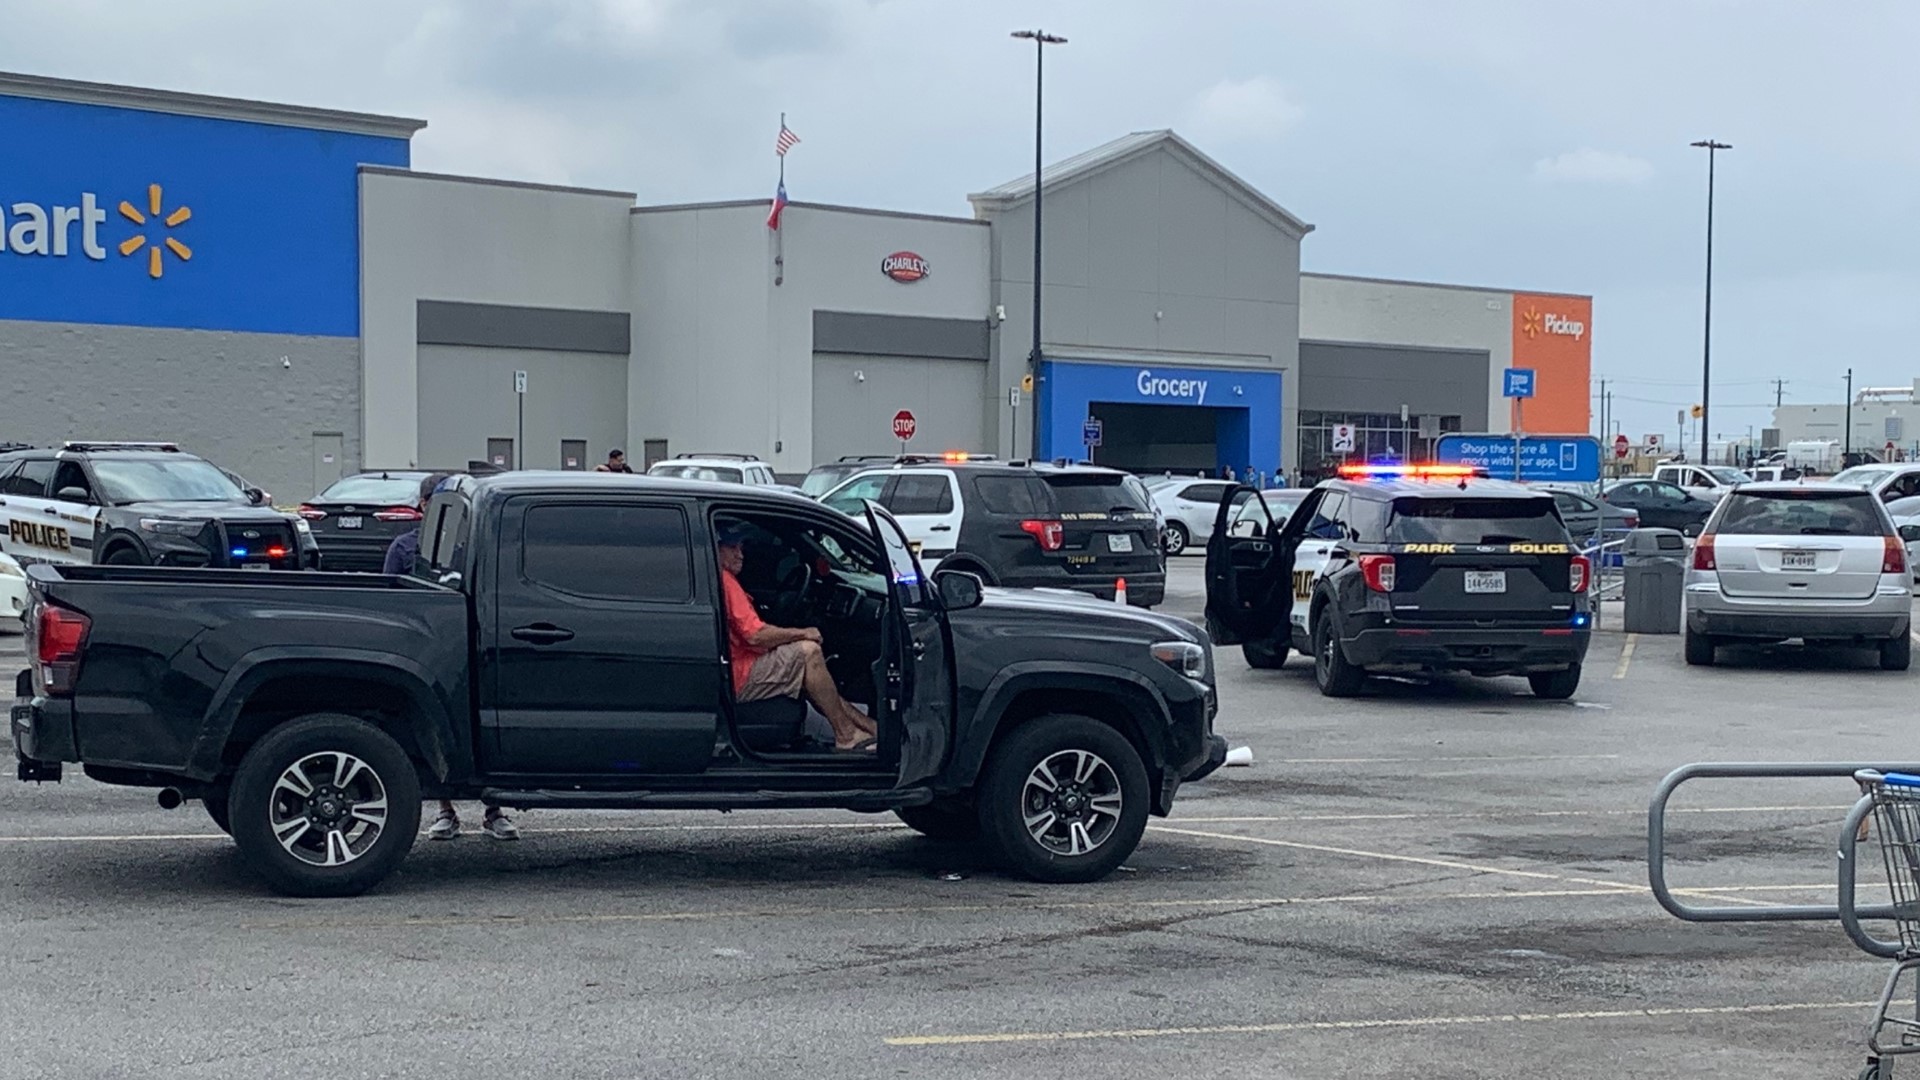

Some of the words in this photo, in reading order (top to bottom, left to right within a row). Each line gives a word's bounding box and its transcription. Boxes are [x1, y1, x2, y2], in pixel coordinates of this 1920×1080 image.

[0, 192, 106, 260] art
[883, 257, 930, 275] CHARLEYS
[1544, 313, 1584, 341] Pickup
[1137, 370, 1207, 405] Grocery
[895, 419, 915, 432] STOP
[1461, 443, 1488, 456] Shop
[1490, 444, 1507, 454] the
[1509, 446, 1537, 454] sore
[1539, 443, 1547, 454] &
[1461, 457, 1489, 466] more
[1491, 456, 1514, 466] with
[1536, 458, 1558, 468] app.
[9, 518, 71, 553] POLICE
[1404, 543, 1457, 554] PARK
[1509, 543, 1569, 554] POLICE
